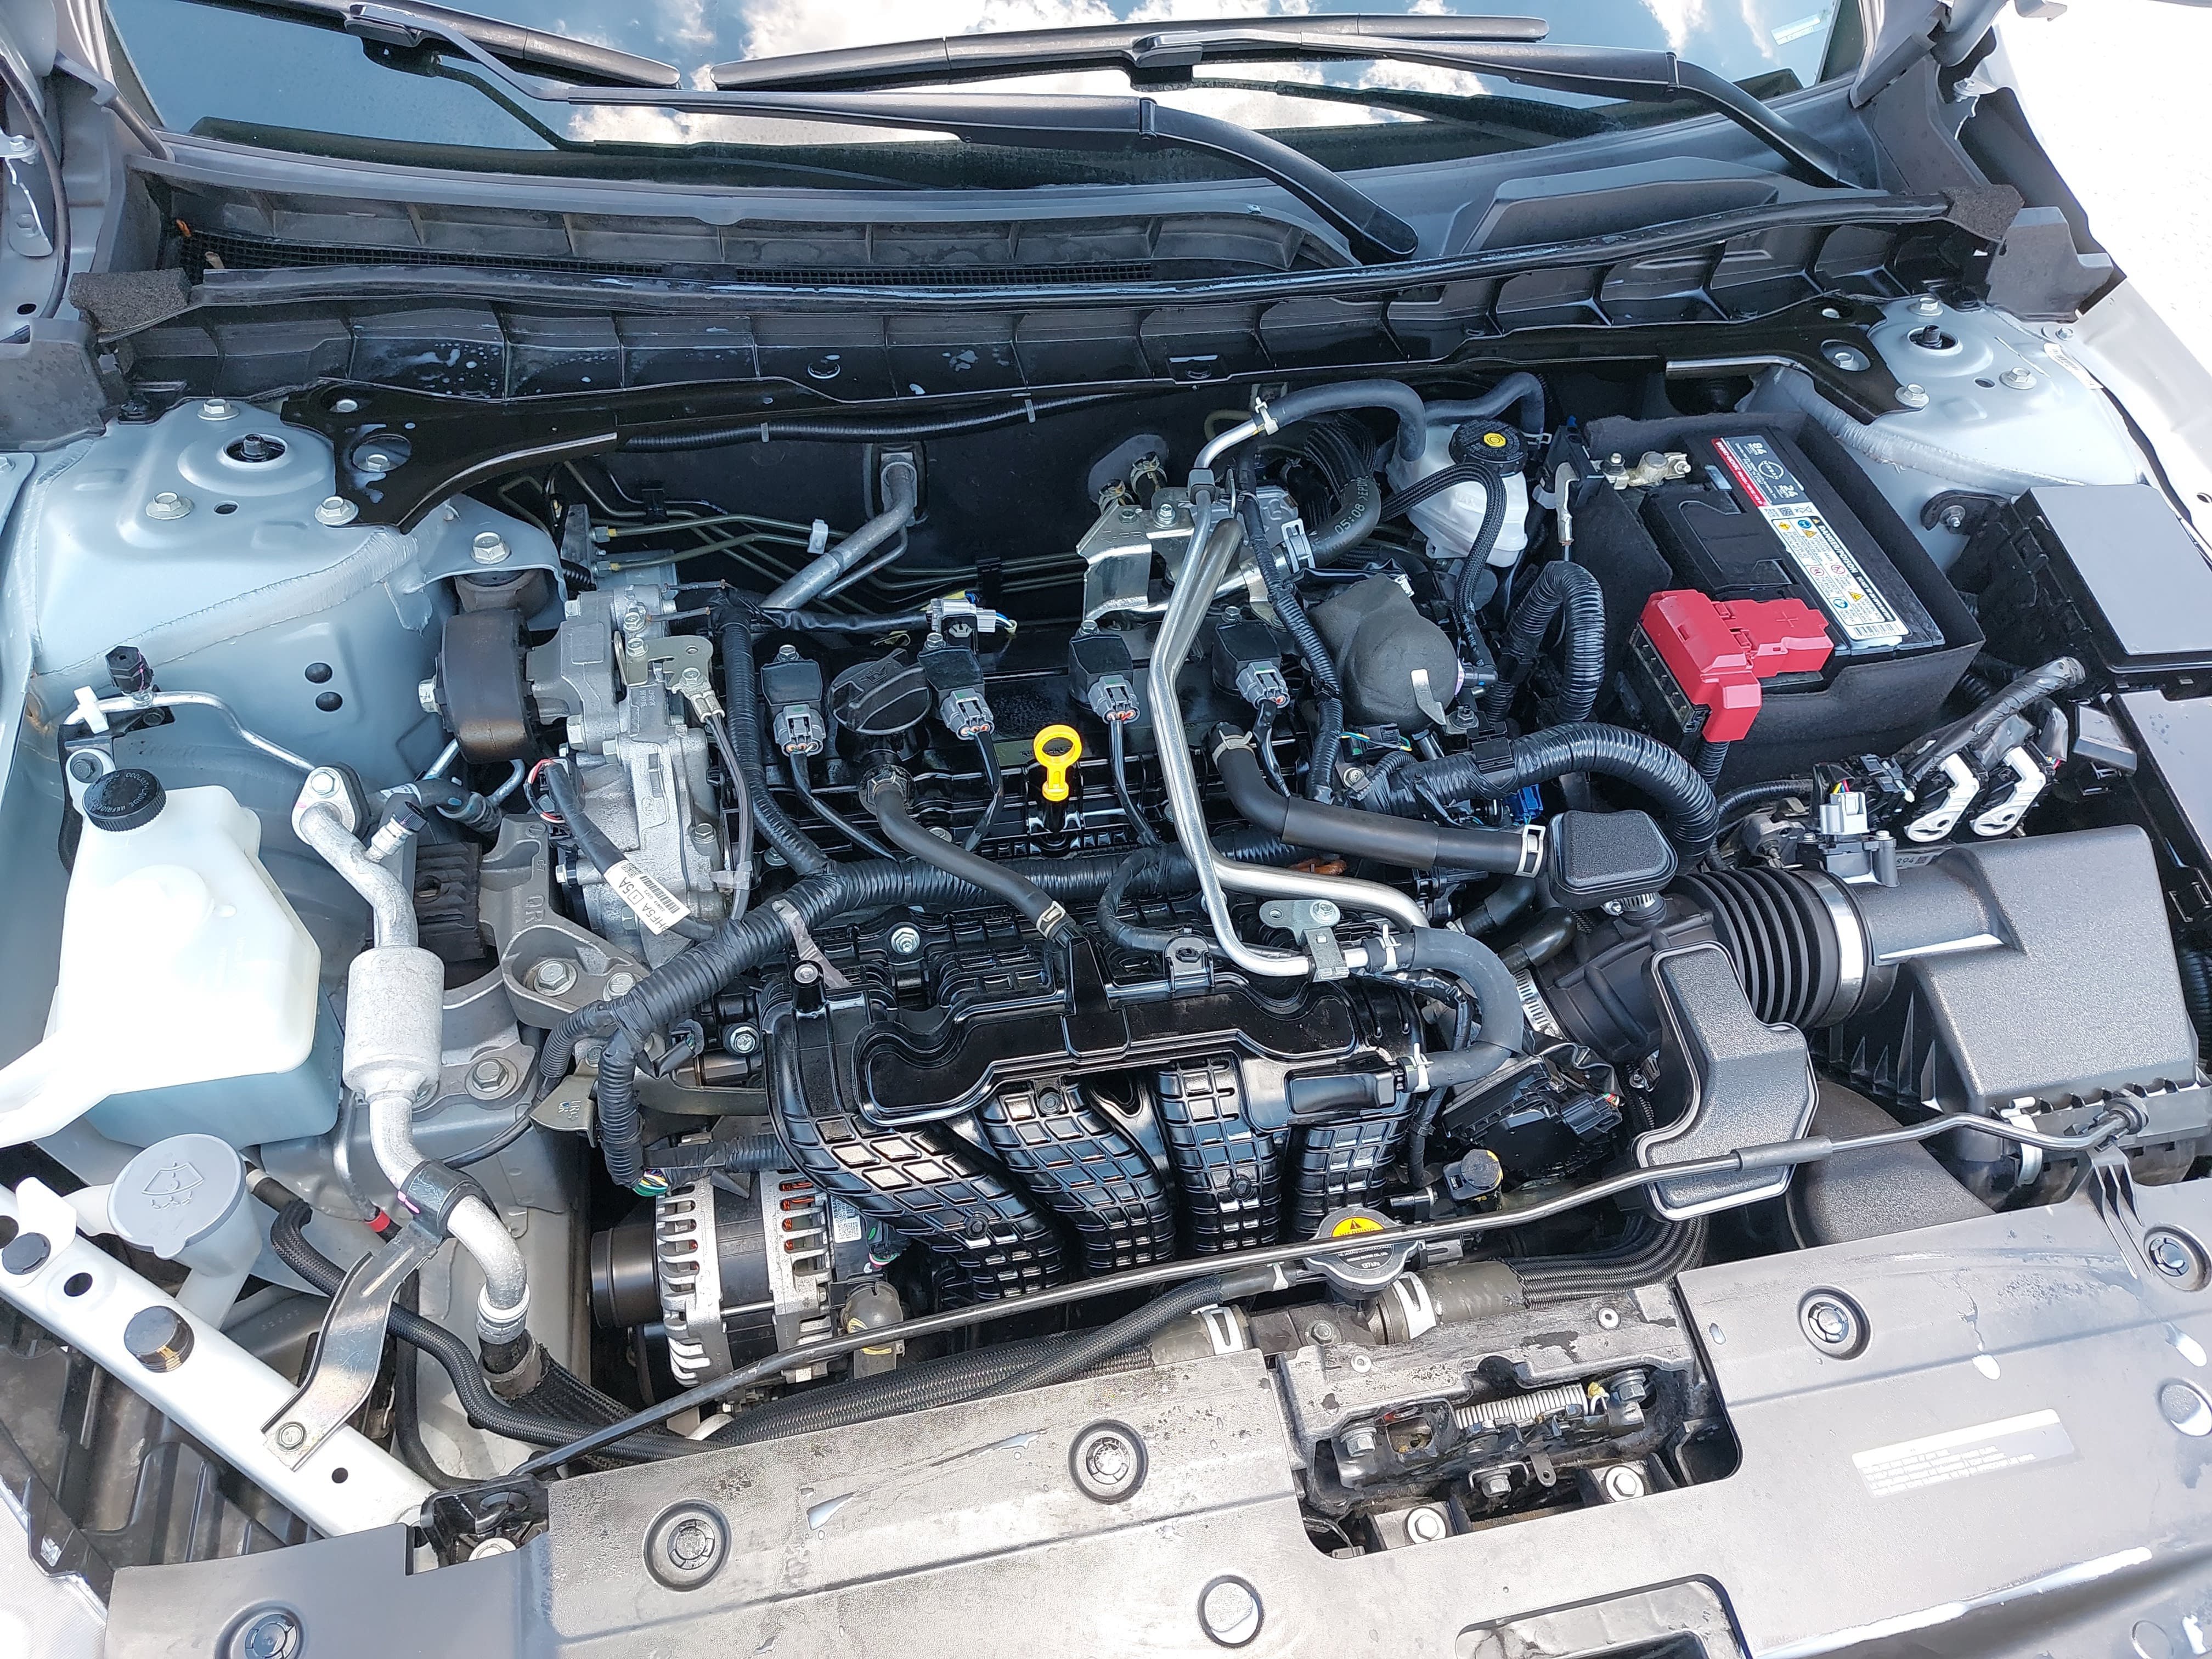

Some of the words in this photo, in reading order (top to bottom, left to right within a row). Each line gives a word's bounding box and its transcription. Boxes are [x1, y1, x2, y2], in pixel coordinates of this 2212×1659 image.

[1747, 442, 1759, 456] MONTH
[1753, 442, 1768, 455] 84
[1761, 460, 1781, 479] NISSAN
[1786, 484, 1798, 496] 24
[1334, 503, 1365, 534] 05:08
[1816, 526, 1859, 573] DANGER/POISON
[619, 877, 634, 894] 5A
[525, 895, 545, 923] QR
